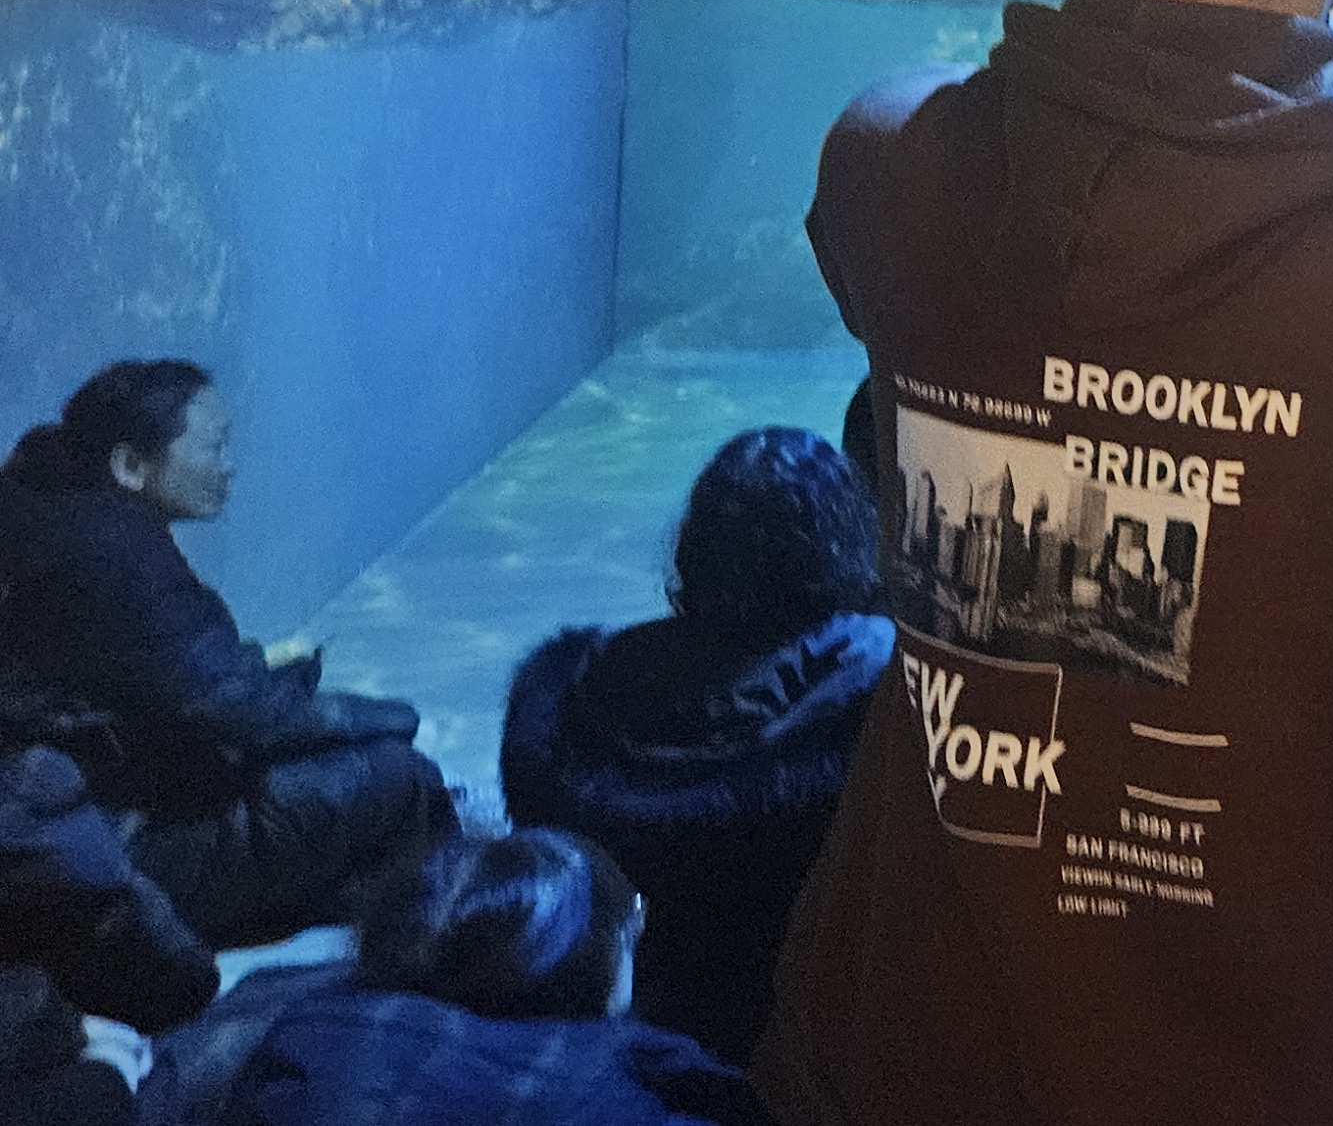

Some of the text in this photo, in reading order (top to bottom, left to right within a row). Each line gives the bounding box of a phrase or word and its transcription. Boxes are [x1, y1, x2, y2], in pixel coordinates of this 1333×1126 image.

[1043, 355, 1302, 437] BROOKLYN
[1065, 433, 1245, 506] BRIDGE
[903, 651, 965, 721] EW
[924, 712, 1066, 795] YORK
[1066, 834, 1204, 879] SAN FRANCISCO
